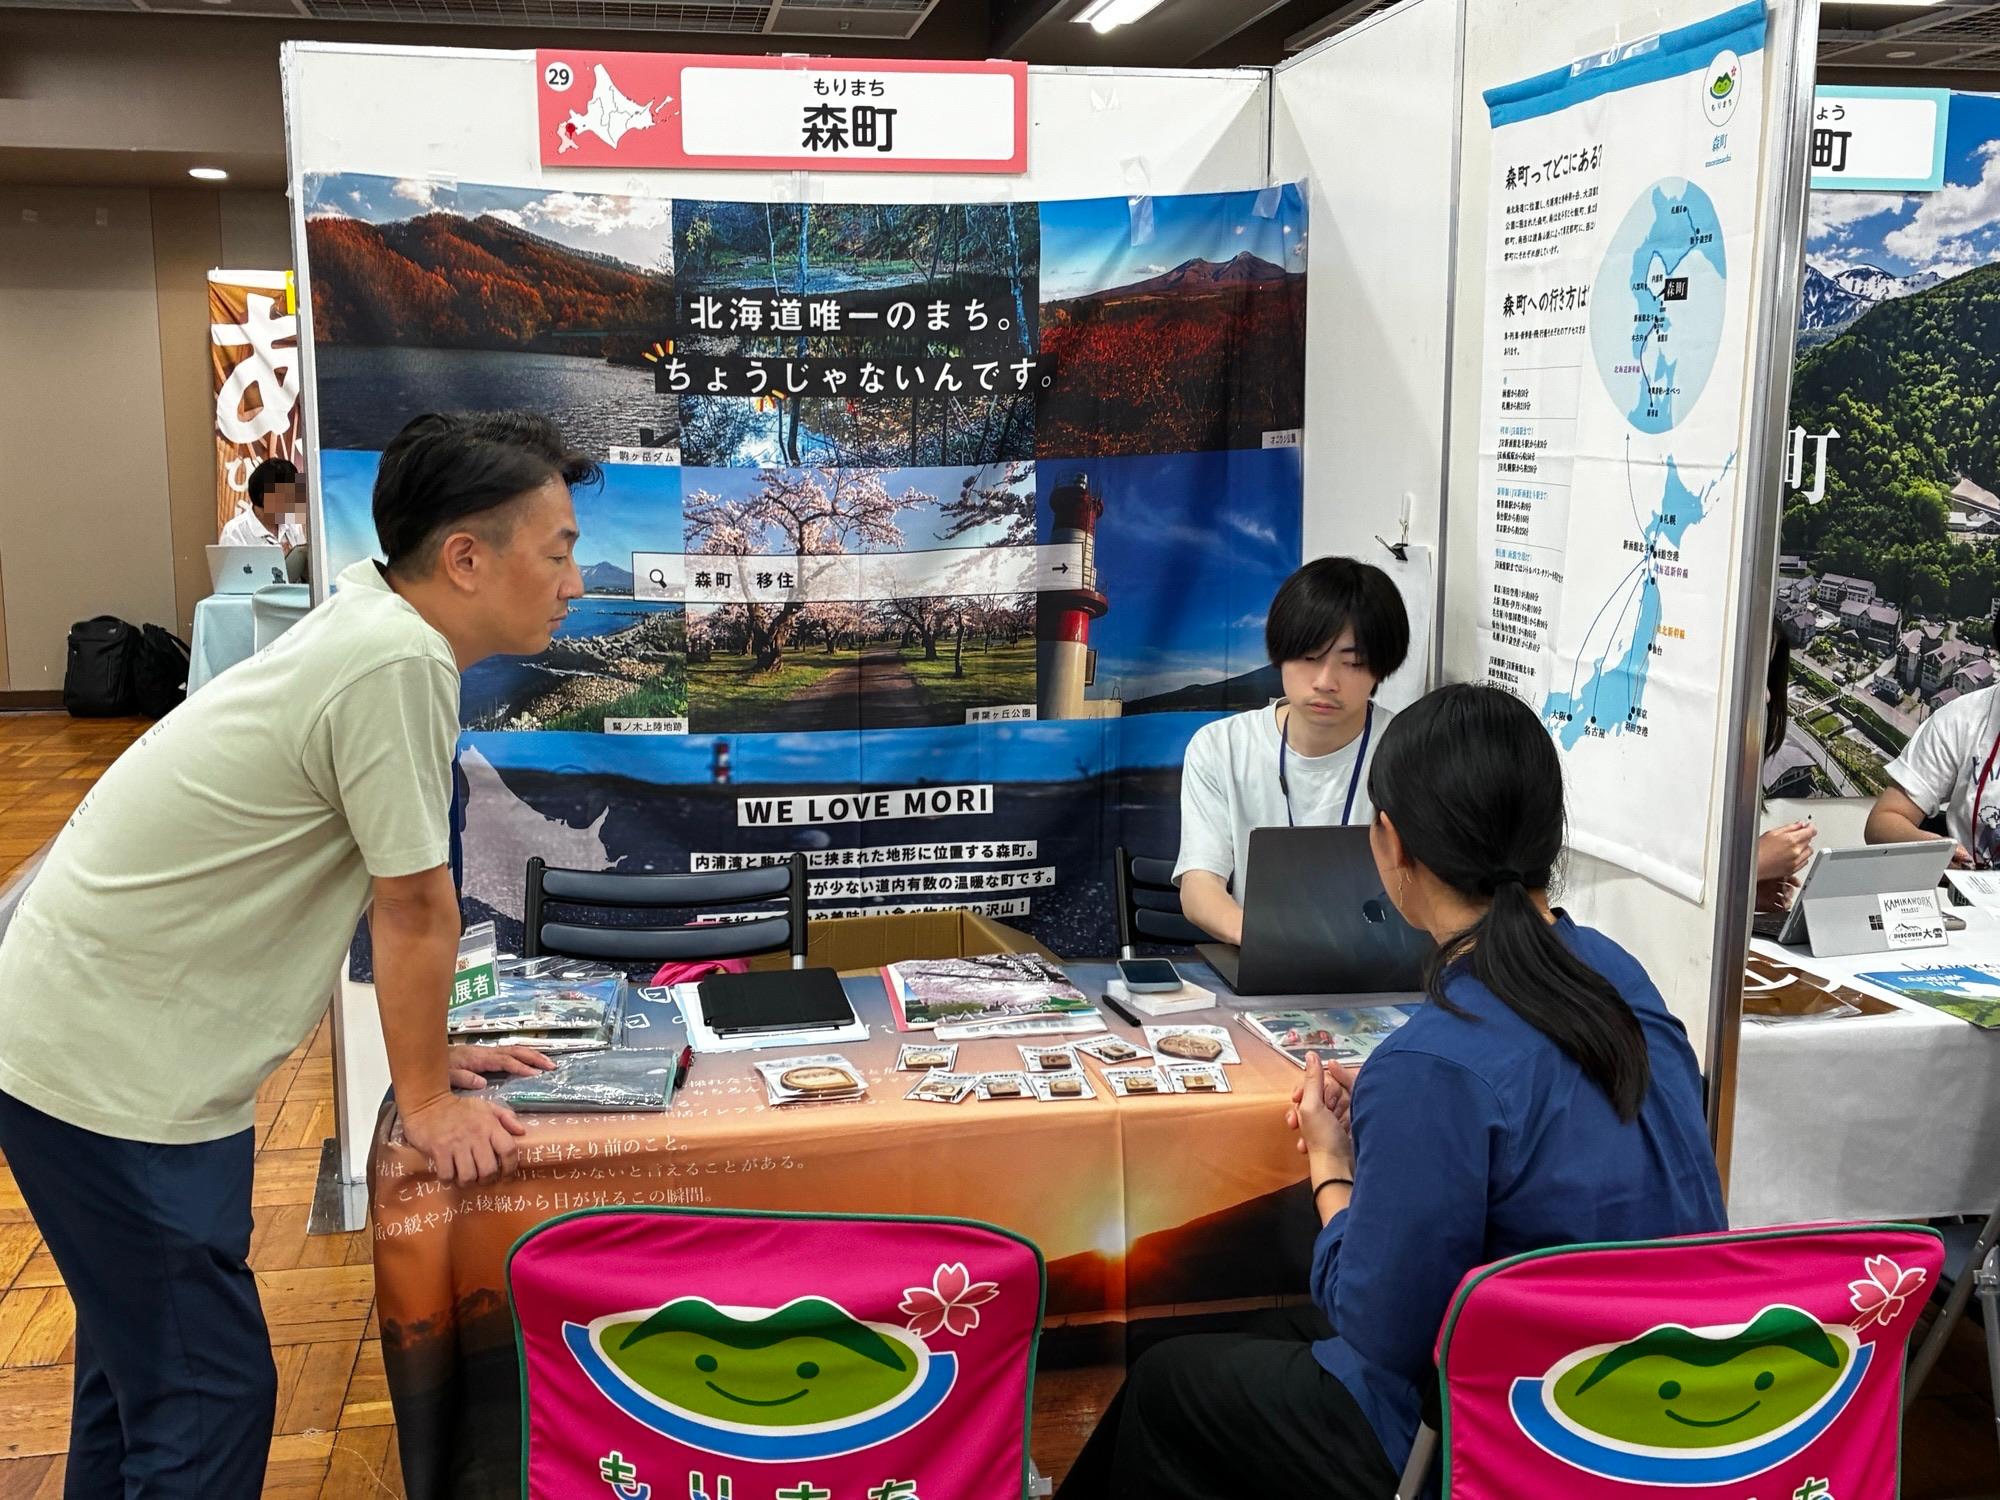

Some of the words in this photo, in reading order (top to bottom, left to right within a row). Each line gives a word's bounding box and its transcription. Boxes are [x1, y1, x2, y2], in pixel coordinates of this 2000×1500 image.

[547, 69, 570, 86] 29
[813, 78, 885, 97] もりまち
[802, 103, 898, 152] 森町
[1811, 128, 1853, 172] 町
[690, 296, 1012, 334] 北海道唯一のまち。
[1502, 284, 1591, 318] 森町への行き方は
[665, 356, 1054, 395] ちょうじゃないんです。
[694, 571, 732, 590] 森町
[756, 571, 794, 590] 移住
[1551, 708, 1567, 721] 大阪
[1584, 724, 1606, 739] 名古屋
[744, 800, 794, 824] WE
[808, 794, 890, 823] LOVE
[903, 786, 988, 817] MORI
[449, 973, 490, 1006] 展者
